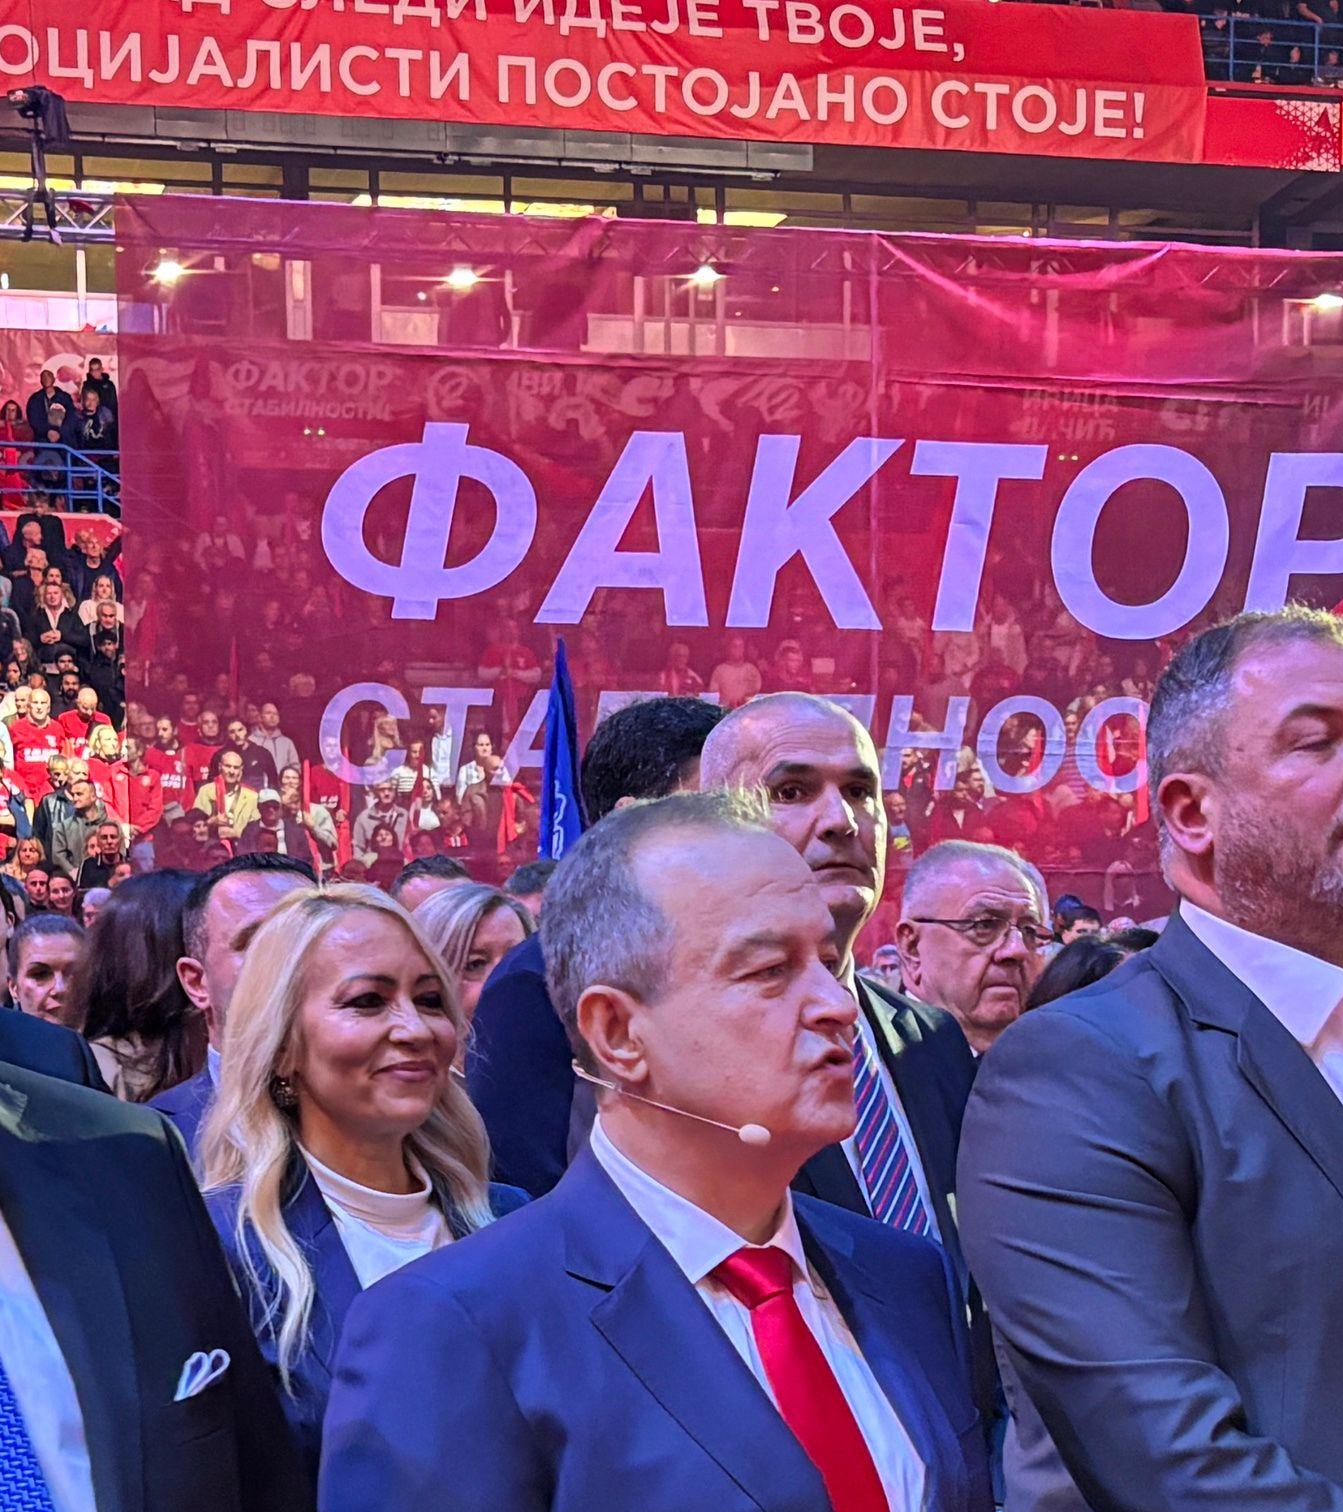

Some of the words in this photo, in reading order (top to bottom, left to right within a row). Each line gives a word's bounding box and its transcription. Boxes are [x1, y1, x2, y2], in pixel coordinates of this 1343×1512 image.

[743, 0, 965, 62] ТВОЈЕ,
[498, 54, 908, 125] ПОСТОЈАНО
[931, 80, 1145, 139] СТОЈЕ!
[318, 681, 1151, 796] СТАНОС
